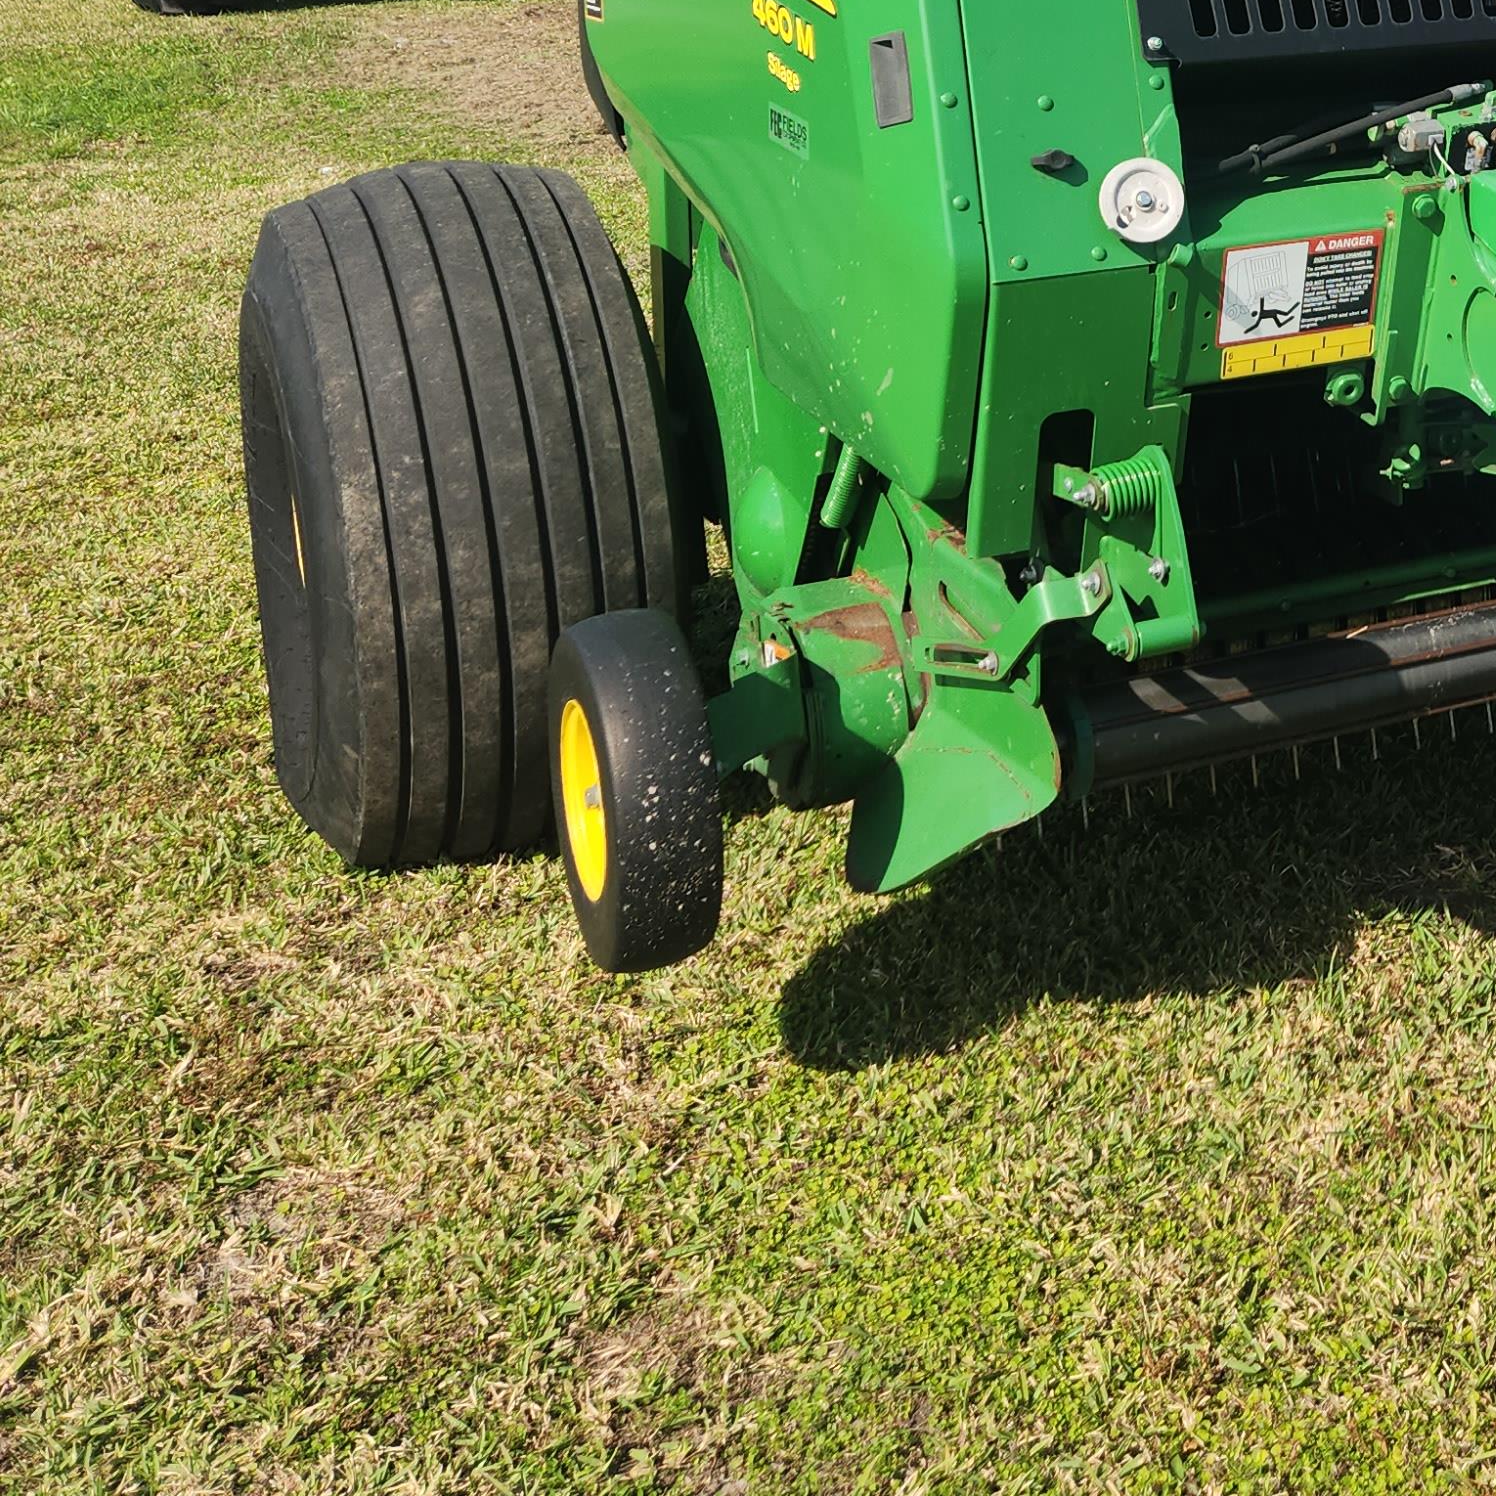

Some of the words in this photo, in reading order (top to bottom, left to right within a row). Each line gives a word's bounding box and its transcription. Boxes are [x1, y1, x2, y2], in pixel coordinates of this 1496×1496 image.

[767, 50, 801, 92] Silage
[783, 115, 807, 141] FIELDS
[1328, 235, 1374, 250] DANGER
